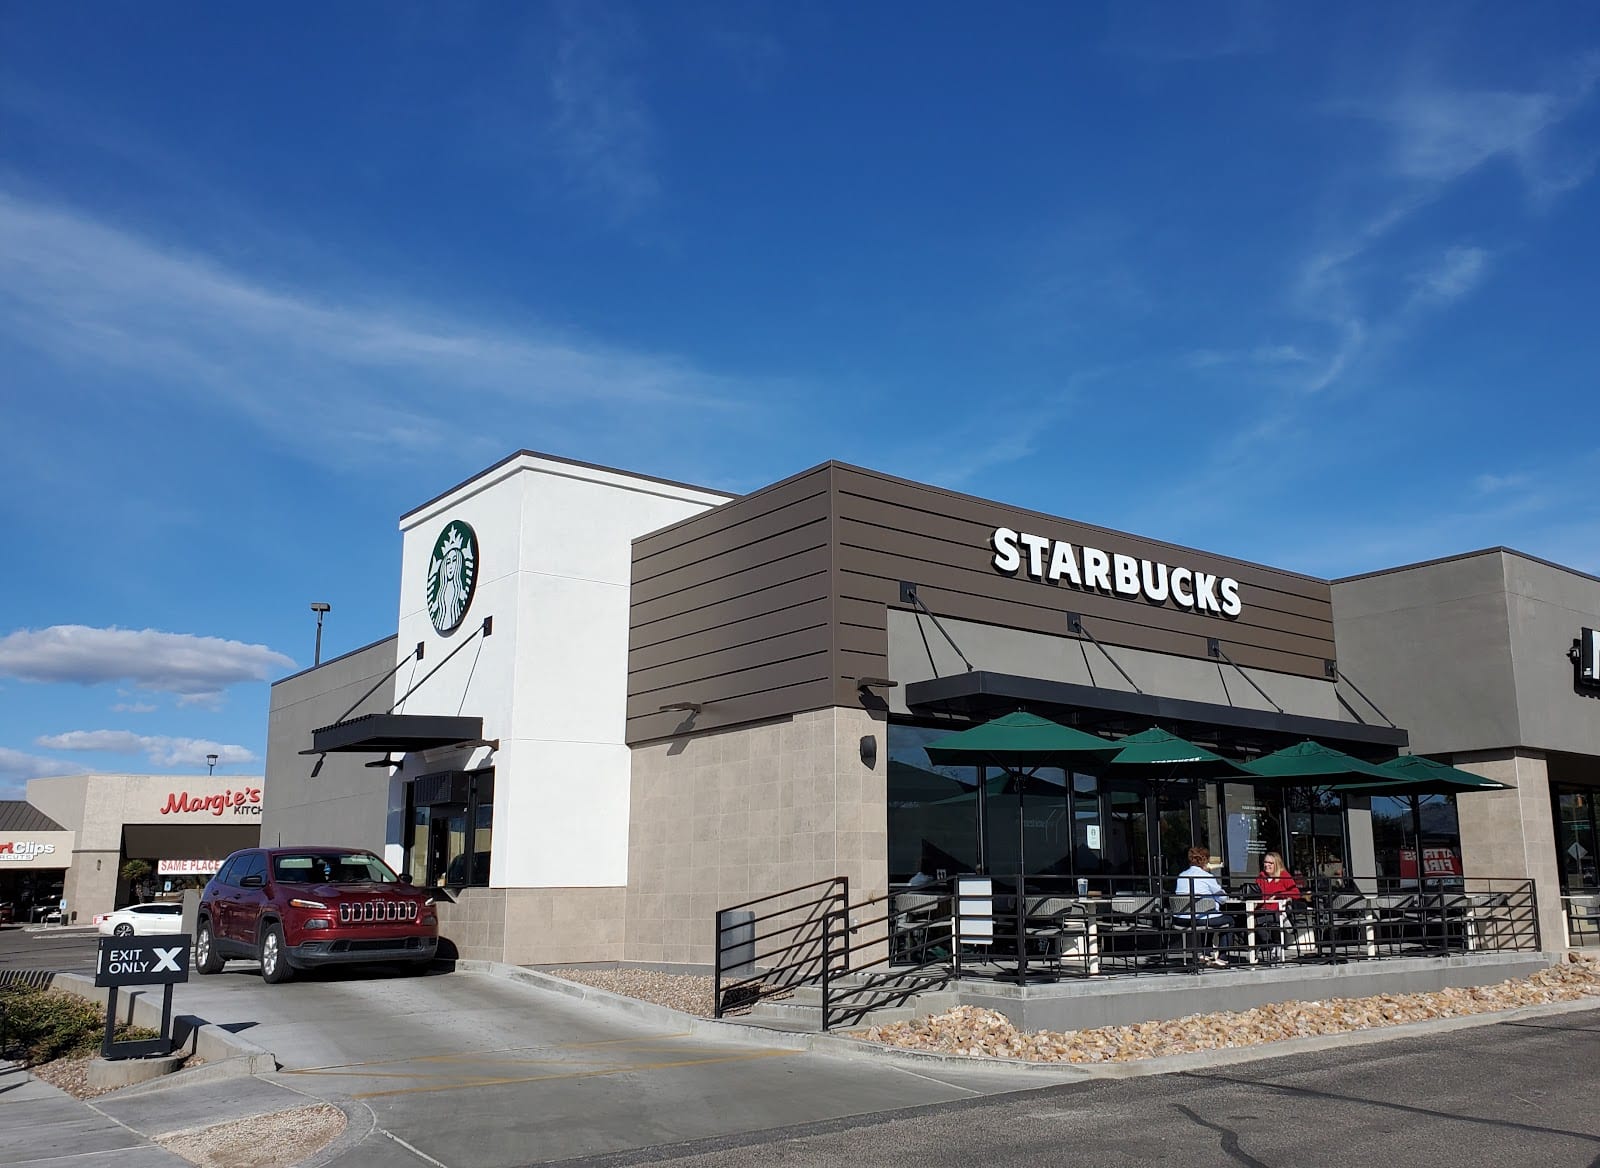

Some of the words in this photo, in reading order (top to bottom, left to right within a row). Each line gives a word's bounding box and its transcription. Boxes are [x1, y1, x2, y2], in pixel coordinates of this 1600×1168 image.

[992, 527, 1242, 619] STARBUCKS
[160, 787, 261, 816] Margie's
[161, 860, 187, 871] SAME
[190, 860, 220, 871] PLACE
[110, 949, 143, 961] EXIT
[108, 961, 149, 974] ONLY
